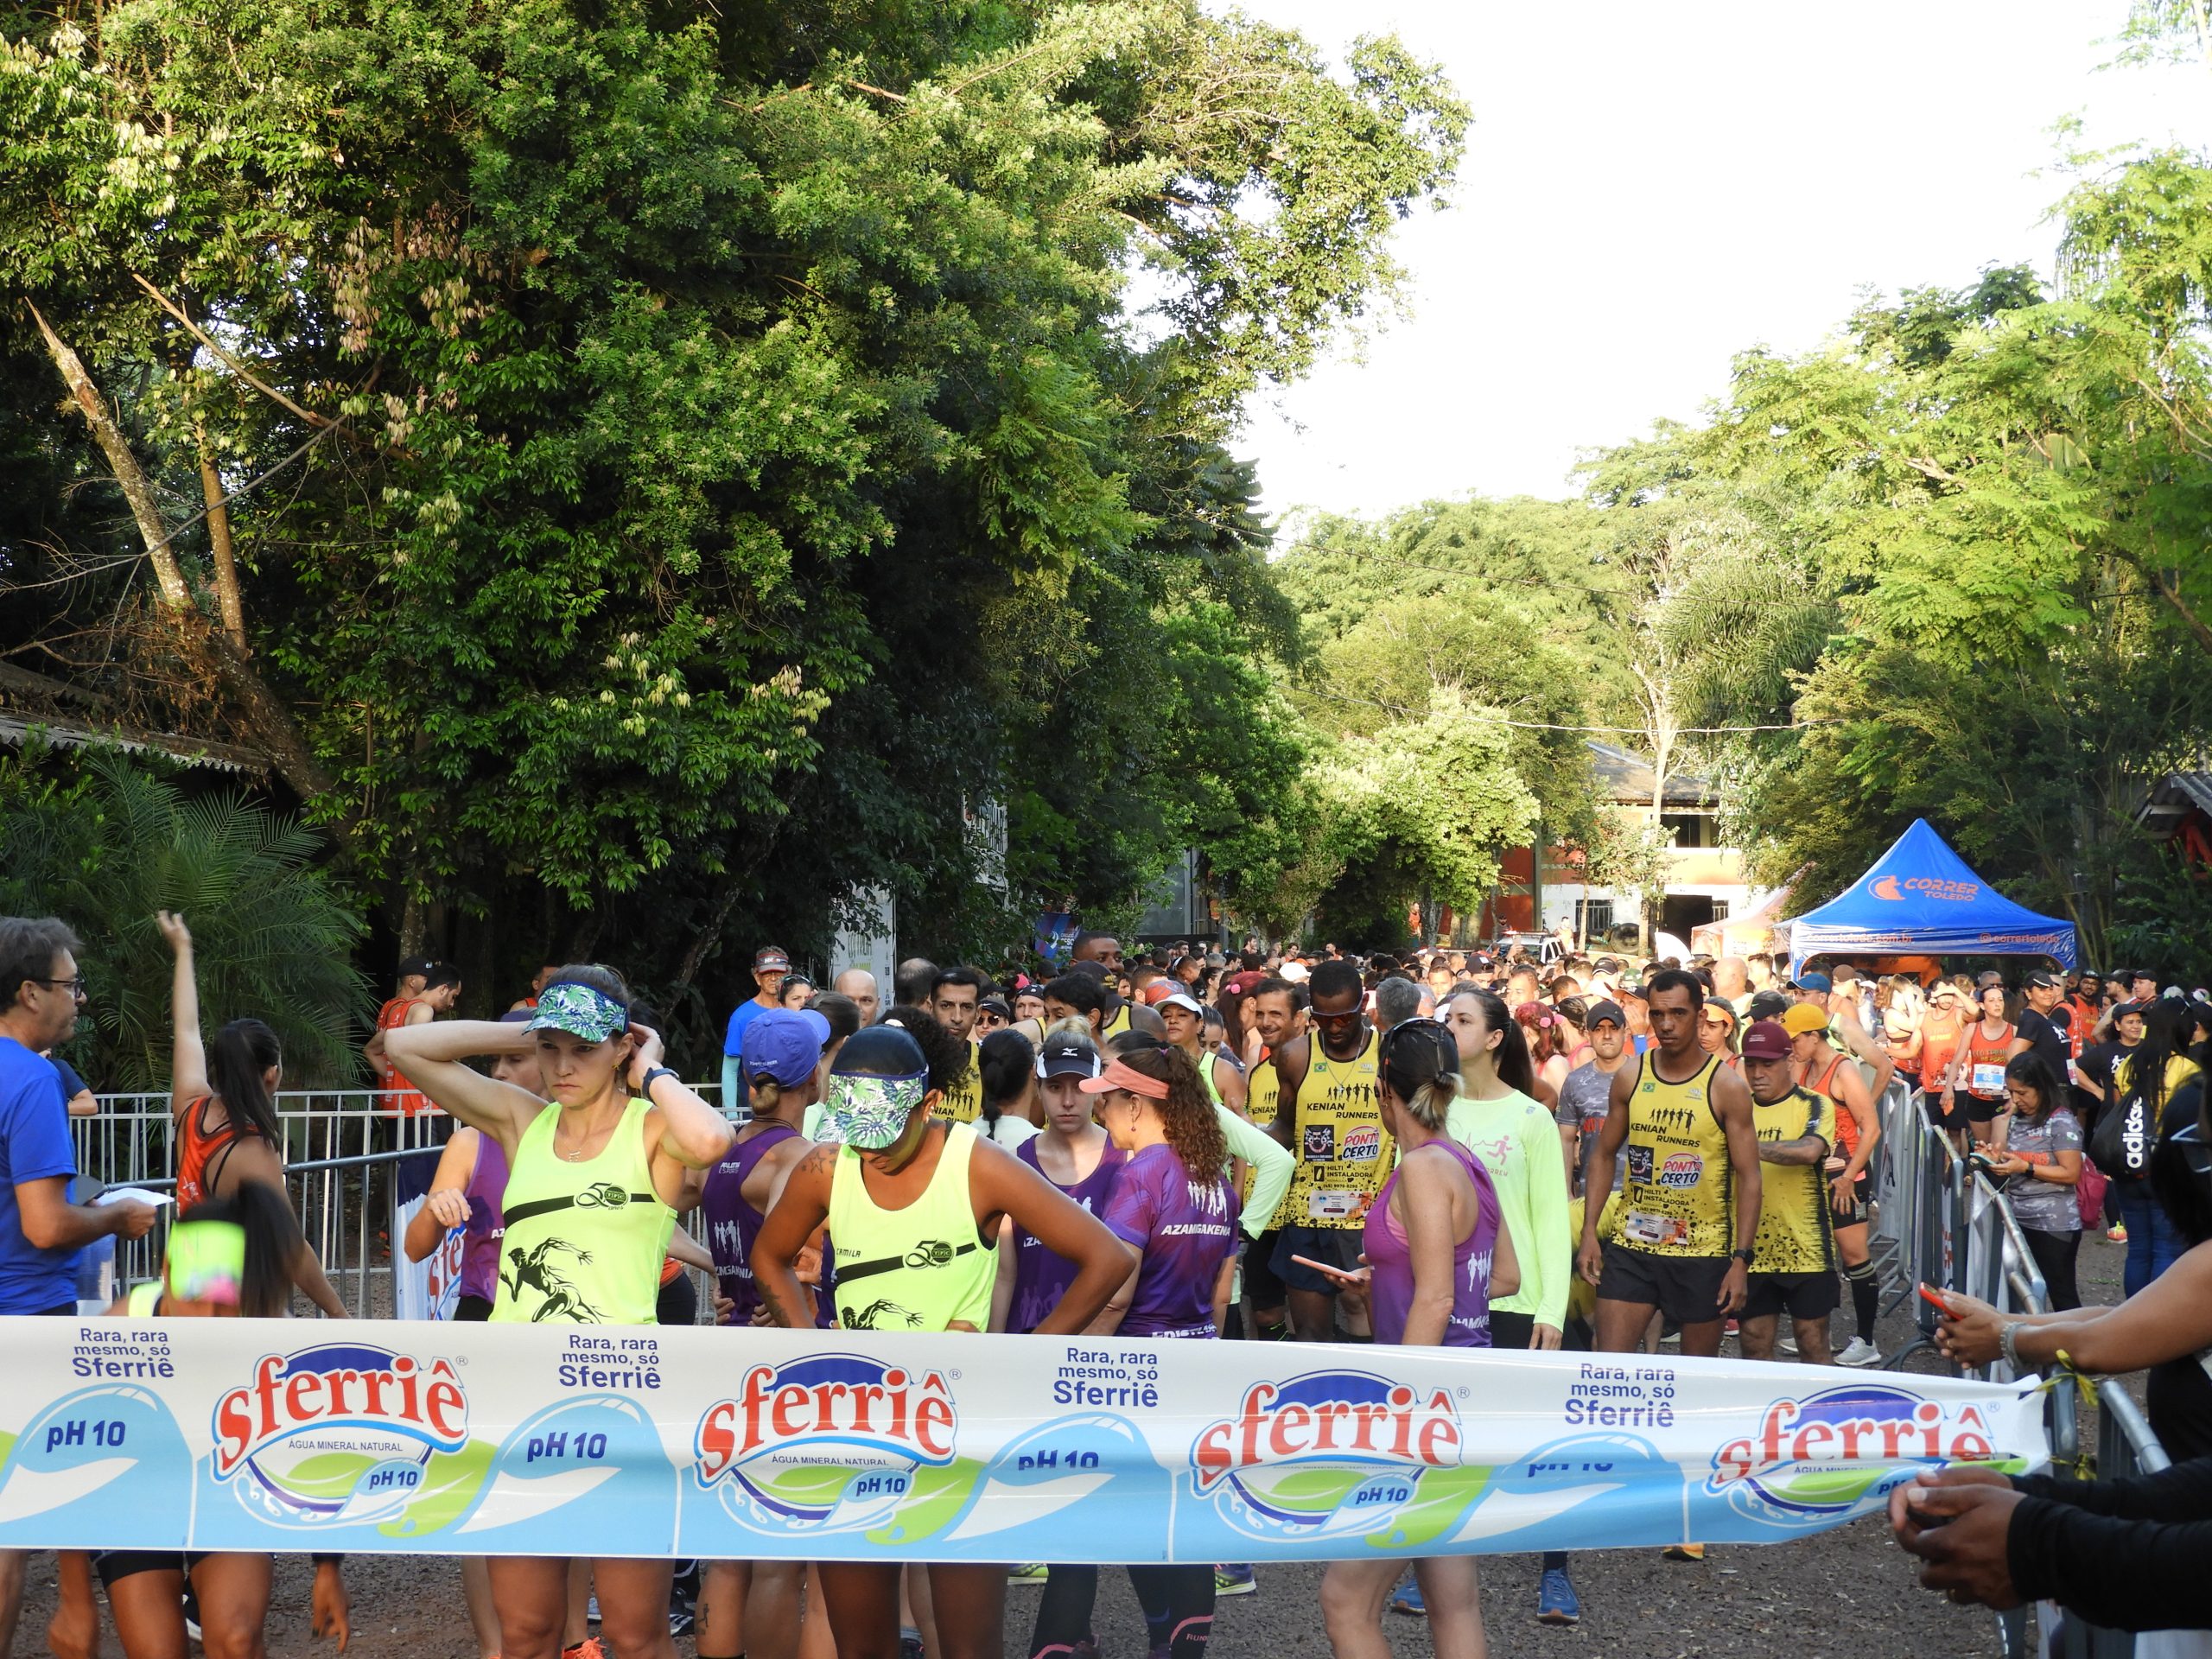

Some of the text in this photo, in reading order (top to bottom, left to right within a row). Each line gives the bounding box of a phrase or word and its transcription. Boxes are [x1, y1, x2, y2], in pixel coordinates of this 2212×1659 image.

[1904, 877, 1980, 895] CORRER
[1923, 891, 1975, 902] TOLEDO
[1306, 1103, 1345, 1111] KENIAN
[1336, 1111, 1379, 1120] RUNNERS
[1630, 1122, 1668, 1135] KENIAN
[1656, 1135, 1700, 1148] RUNNERS
[1342, 1143, 1378, 1160] CERTO
[1661, 1172, 1699, 1185] CERTO
[1643, 1195, 1690, 1207] INSTALADORA
[836, 1247, 861, 1258] CAMILA
[80, 1327, 168, 1344] Rara, rara
[569, 1334, 658, 1351] Rara, rara
[74, 1344, 170, 1357] mesmo, só
[562, 1351, 659, 1366] mesmo, só
[1067, 1347, 1158, 1365] Rara, rara
[72, 1357, 175, 1378] Sferriê
[1058, 1366, 1158, 1382] mesmo, só
[1580, 1363, 1675, 1382] Rara, rara
[558, 1364, 661, 1389] Sferriê
[1053, 1380, 1159, 1408] Sferriê
[1571, 1383, 1675, 1400] mesmo, só
[219, 1356, 465, 1471] sferriê
[1565, 1398, 1675, 1427] Sferriê
[702, 1367, 954, 1478] sferriê
[46, 1420, 126, 1453] pH 10
[1197, 1384, 1459, 1486] sferriê
[288, 1438, 404, 1452] ÁGUA MINERAL NATURAL
[527, 1431, 607, 1463] pH 10
[772, 1453, 889, 1466] ÁGUA MINERAL NATURAL
[1018, 1449, 1099, 1471] pH 10
[1794, 1464, 1823, 1474] ÁGUA
[369, 1471, 418, 1490] pH 10
[855, 1478, 906, 1497] pH 10
[1355, 1487, 1408, 1505] pH 10
